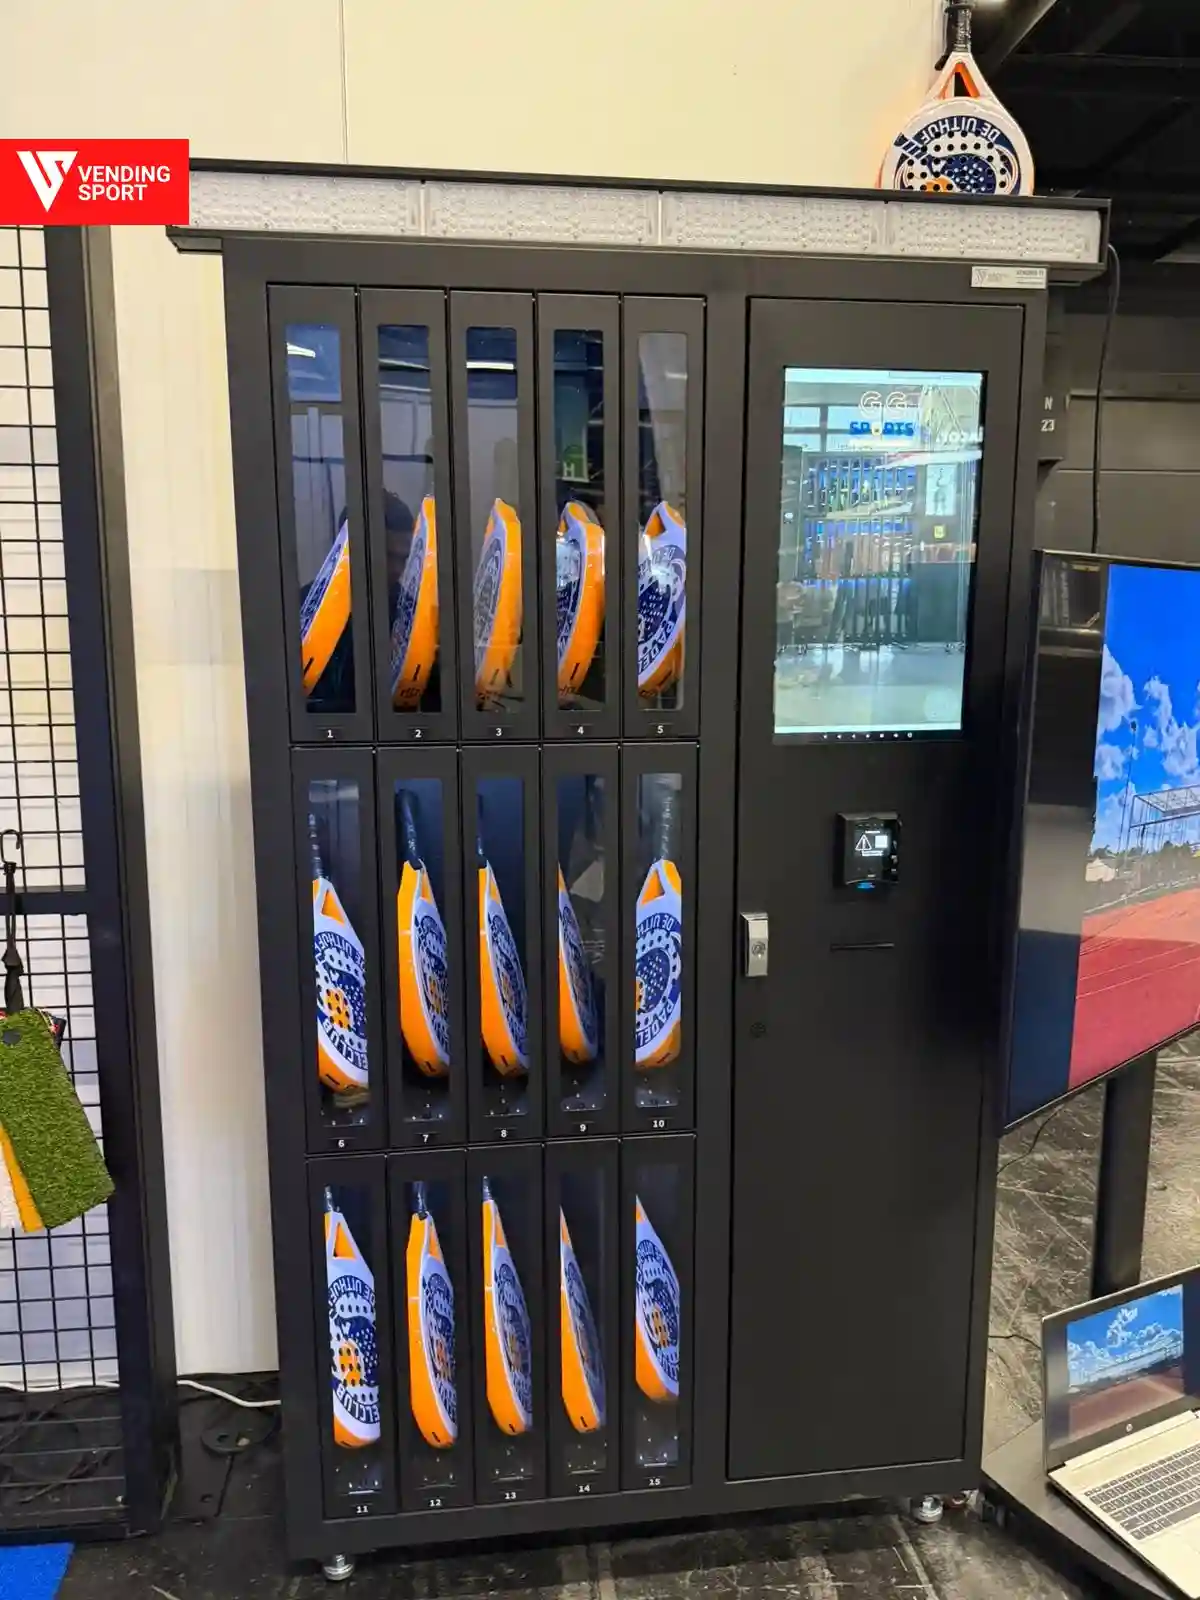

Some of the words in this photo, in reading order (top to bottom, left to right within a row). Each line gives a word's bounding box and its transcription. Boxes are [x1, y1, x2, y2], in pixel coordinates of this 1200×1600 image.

[980, 121, 1001, 144] DE
[1044, 395, 1054, 411] N
[1040, 419, 1055, 432] 23
[327, 729, 334, 738] 1
[415, 729, 422, 738] 2
[495, 727, 502, 737] 3
[577, 726, 584, 735] 4
[657, 725, 664, 734] 5
[579, 1123, 587, 1132] 9
[653, 1119, 665, 1128] 10
[500, 1129, 507, 1138] 8
[422, 1134, 429, 1143] 7
[338, 1139, 345, 1148] 6
[649, 1478, 661, 1486] 15
[578, 1484, 591, 1493] 14
[505, 1491, 517, 1500] 13
[430, 1498, 441, 1507] 12
[356, 1505, 369, 1514] 11
